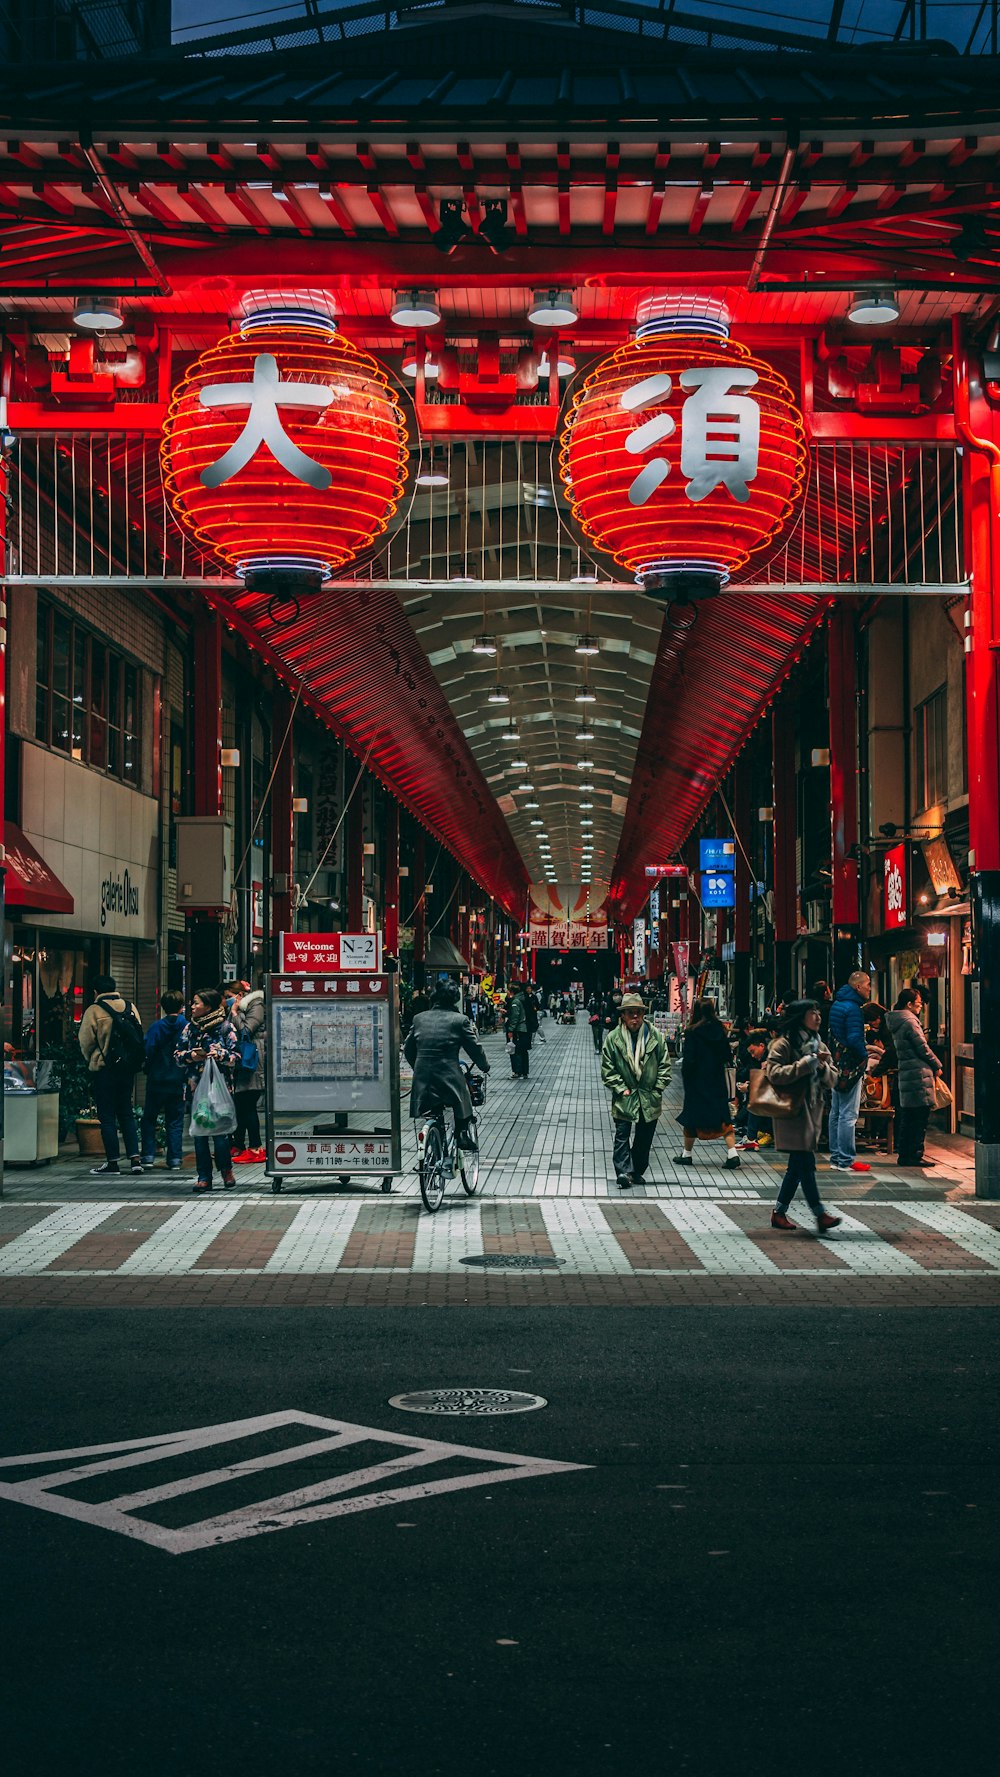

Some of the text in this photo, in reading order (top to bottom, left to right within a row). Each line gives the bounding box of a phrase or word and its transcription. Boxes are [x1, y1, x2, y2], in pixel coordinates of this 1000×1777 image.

[198, 353, 335, 490] 大
[620, 366, 760, 506] 須
[531, 930, 606, 947] 謹賀新年
[293, 941, 334, 951] Welcome
[342, 939, 374, 953] N-2
[286, 952, 308, 963] 환영
[313, 952, 338, 963] 欢迎
[306, 1143, 389, 1154] 車両進入禁止
